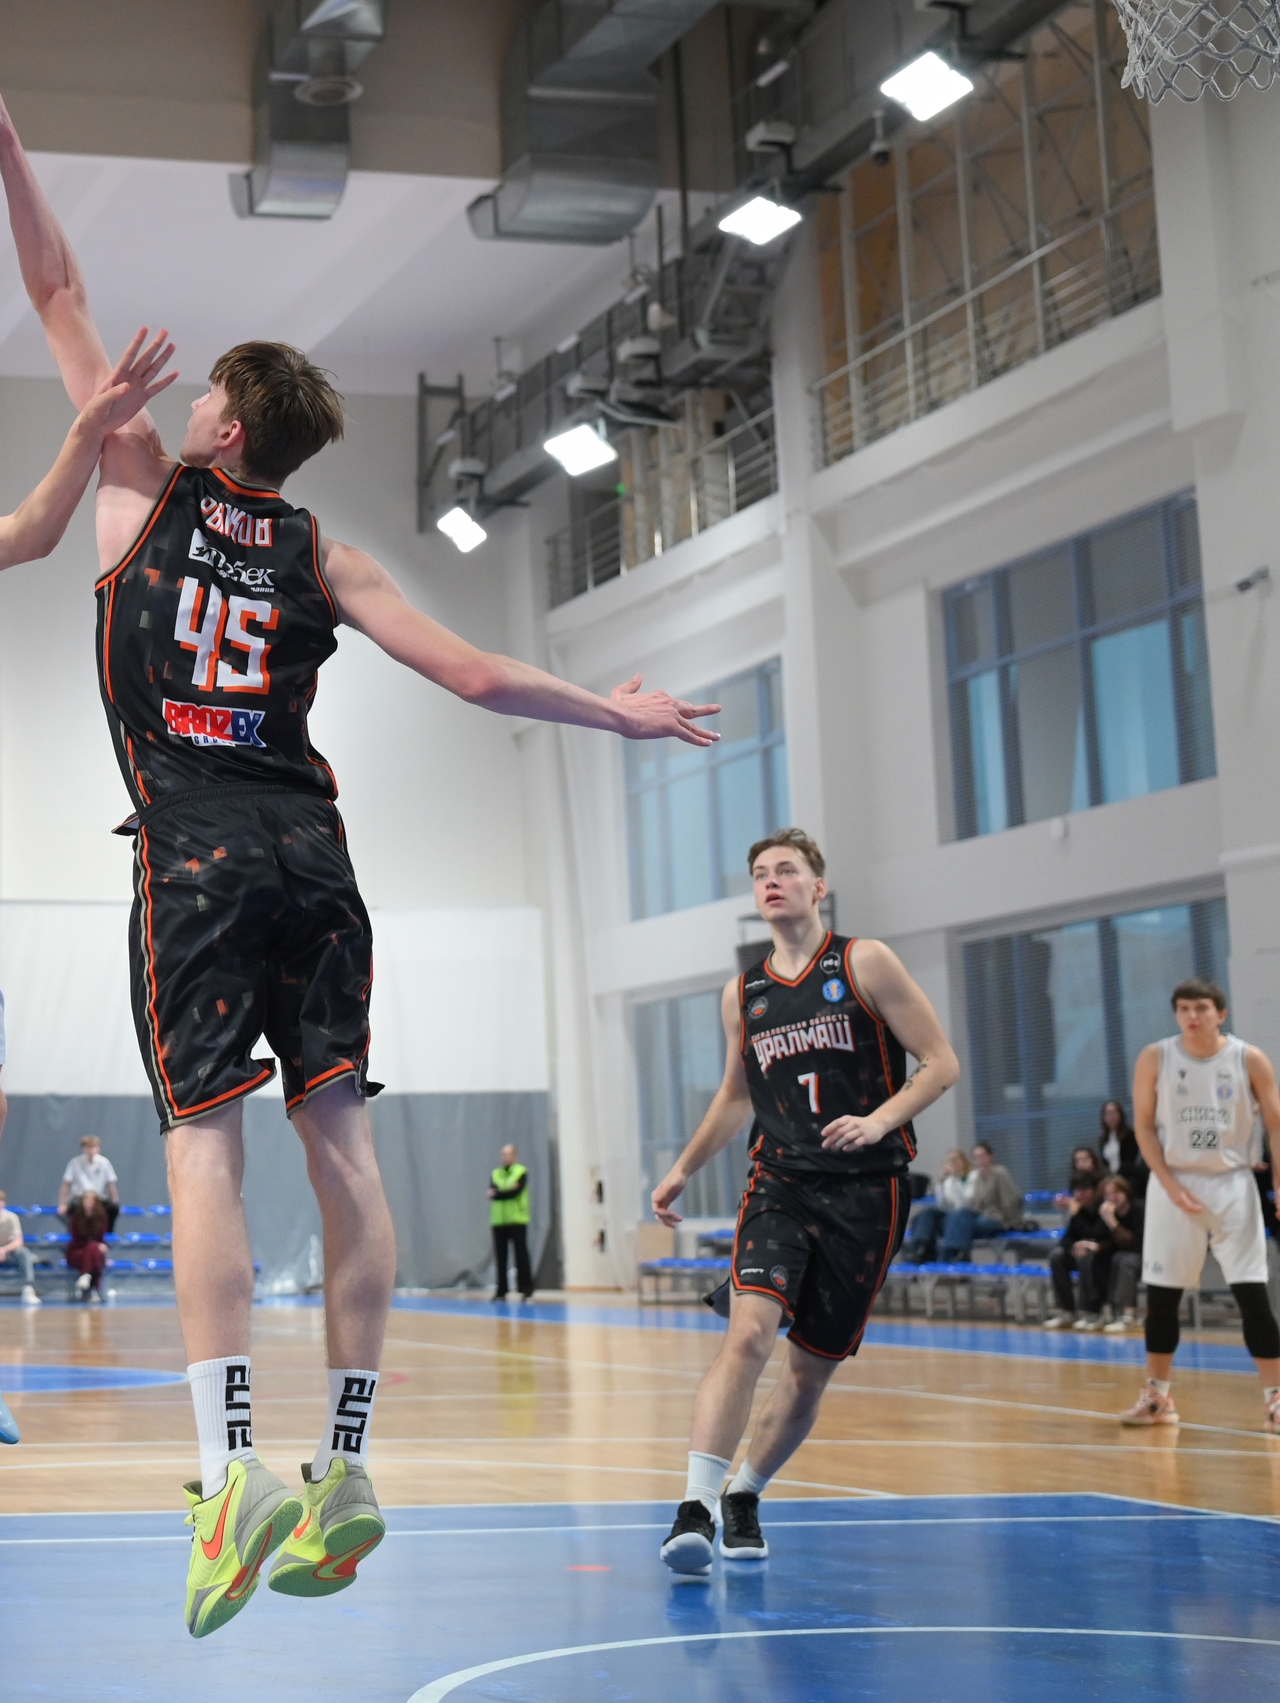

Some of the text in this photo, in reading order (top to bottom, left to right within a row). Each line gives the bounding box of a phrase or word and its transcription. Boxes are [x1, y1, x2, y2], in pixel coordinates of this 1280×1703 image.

[174, 576, 277, 693] 45
[165, 700, 263, 746] BROZEX
[753, 1020, 855, 1073] УРАЛМАШ
[797, 1072, 821, 1115] 7
[1191, 1129, 1219, 1149] 22
